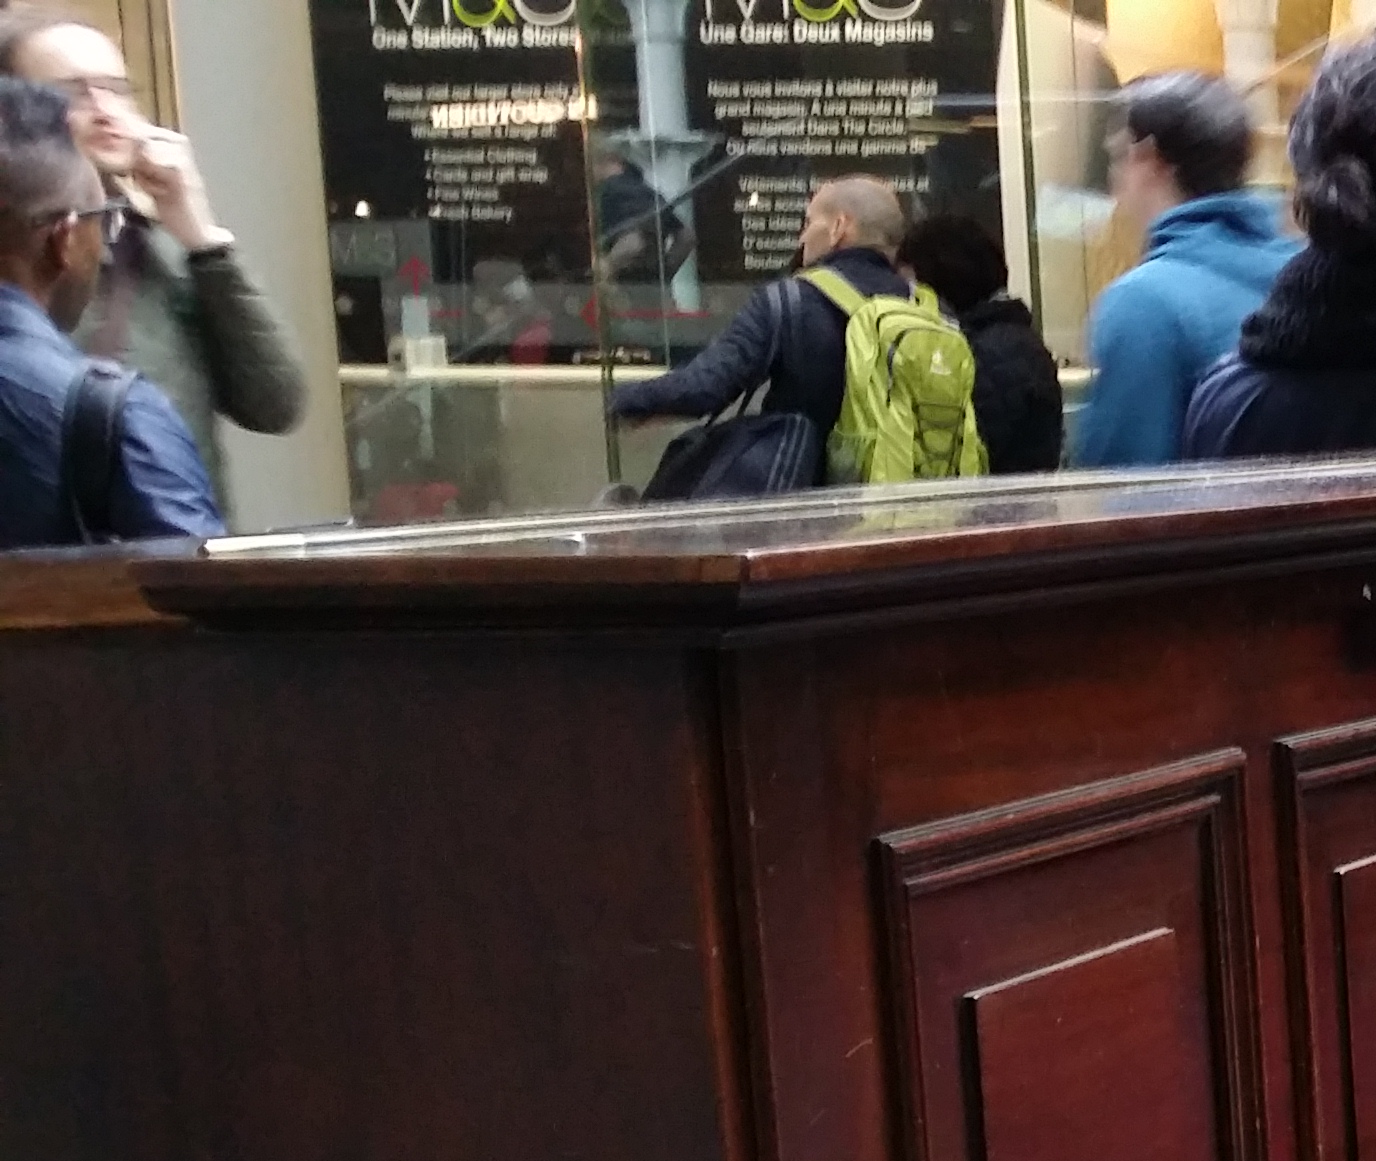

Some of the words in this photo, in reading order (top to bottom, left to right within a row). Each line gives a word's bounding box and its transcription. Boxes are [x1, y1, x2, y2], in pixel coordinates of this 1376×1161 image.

[372, 25, 407, 50] One
[412, 25, 480, 50] Station,
[484, 24, 519, 48] Two
[700, 20, 735, 44] Une
[793, 20, 840, 43] Deux
[845, 18, 934, 46] Magasins
[708, 79, 739, 97] Nous
[743, 79, 772, 97] vous
[843, 117, 866, 134] The
